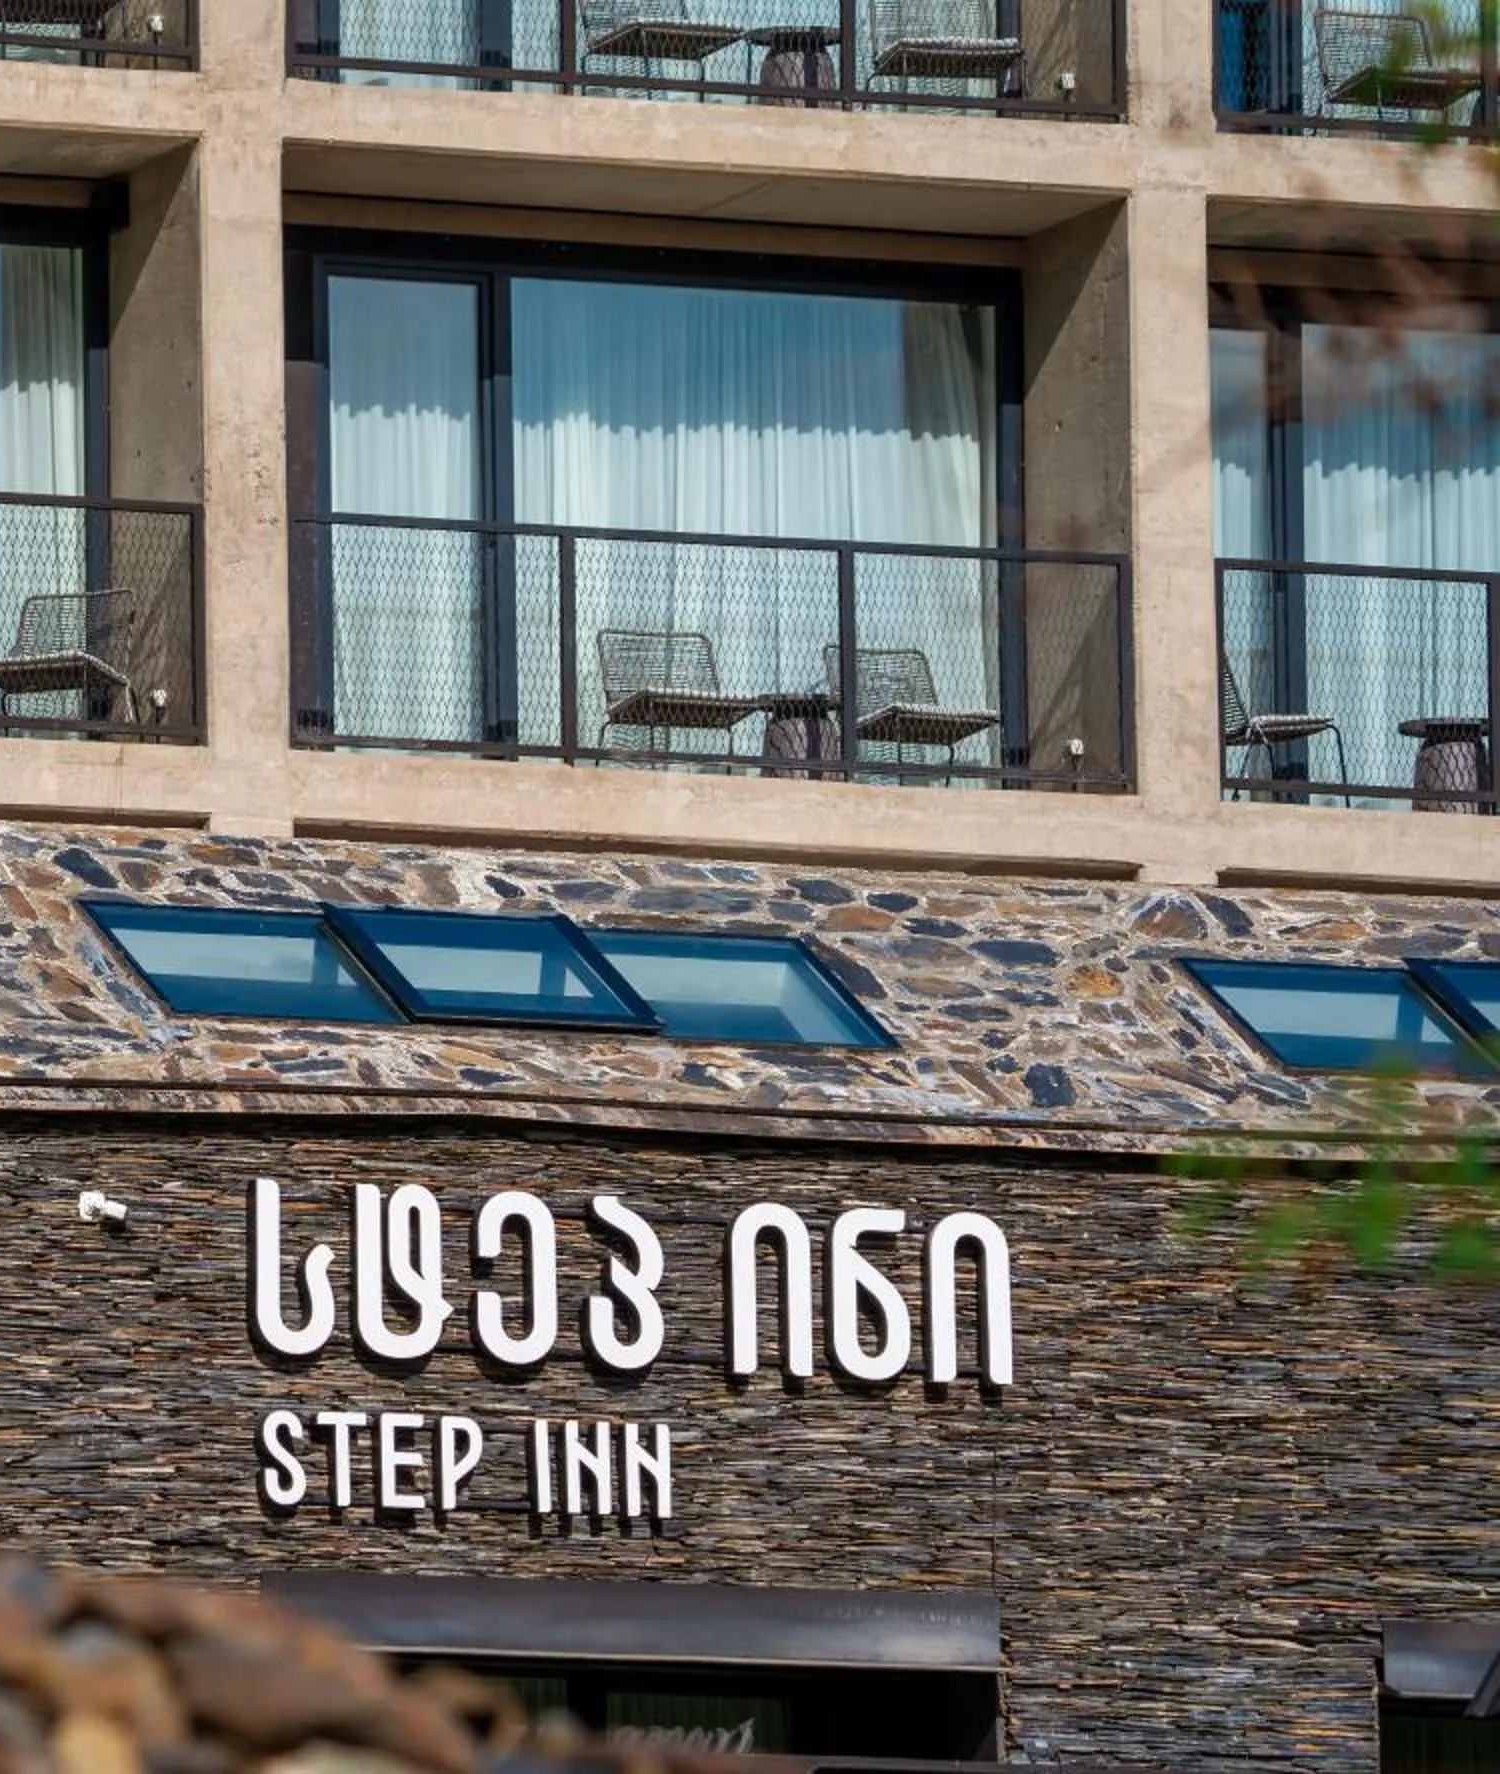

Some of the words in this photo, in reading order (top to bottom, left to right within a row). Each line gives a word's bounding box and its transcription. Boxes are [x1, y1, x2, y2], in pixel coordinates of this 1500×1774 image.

[730, 1202, 1012, 1385] ინი
[262, 1409, 483, 1511] STEP
[534, 1418, 672, 1519] INN
